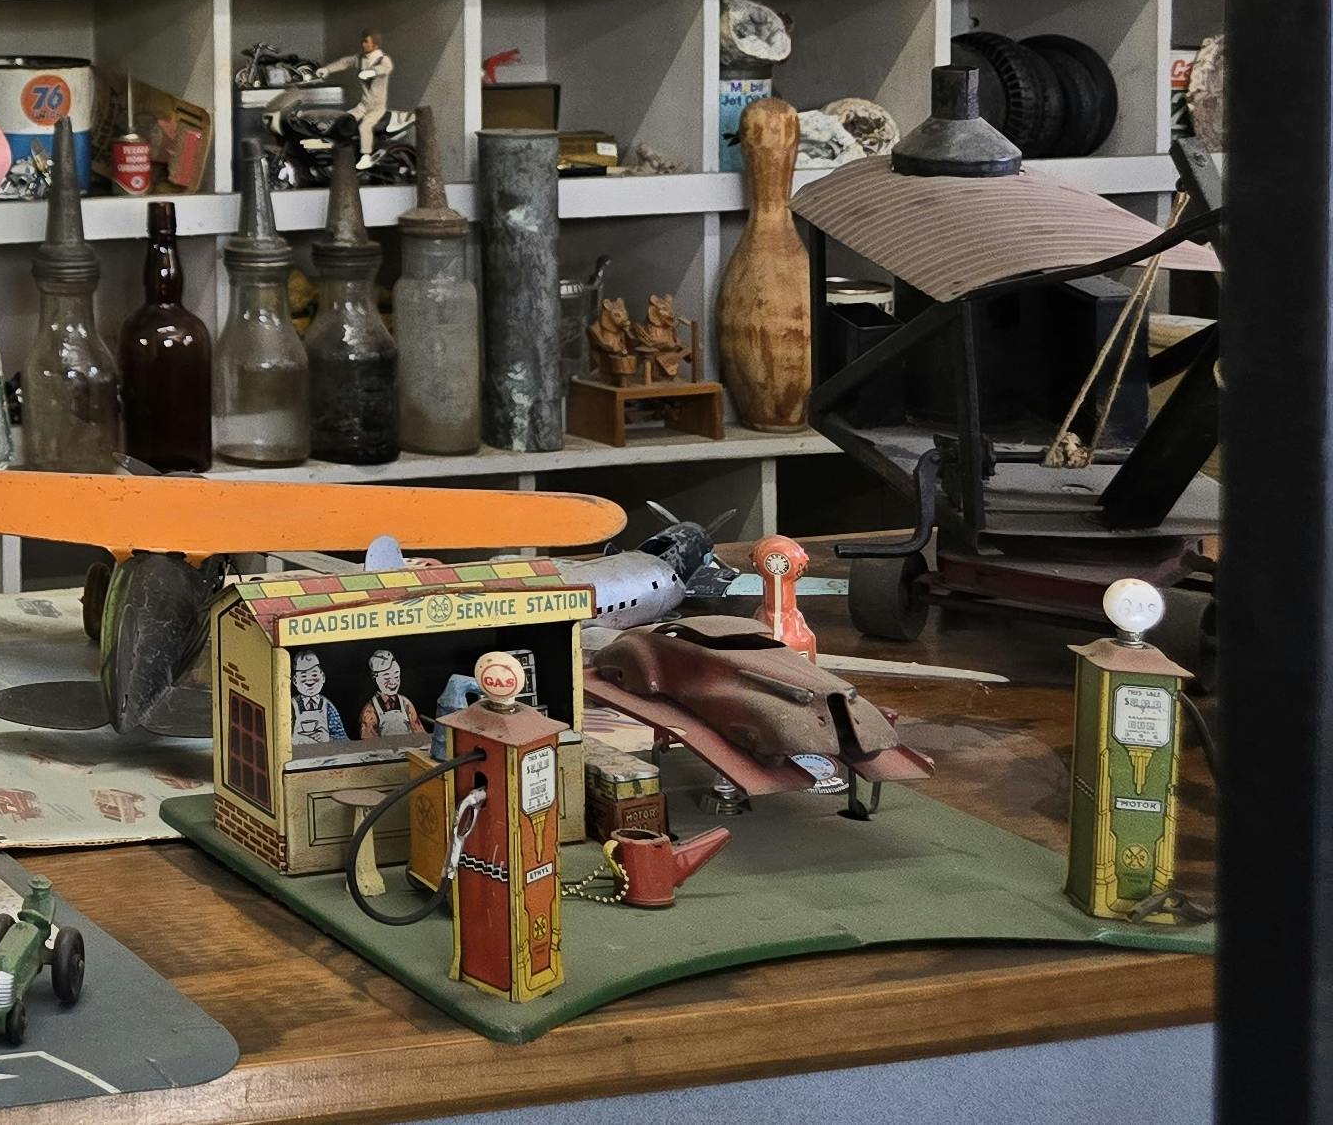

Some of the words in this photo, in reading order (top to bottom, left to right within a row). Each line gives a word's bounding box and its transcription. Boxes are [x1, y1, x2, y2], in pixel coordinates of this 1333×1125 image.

[32, 86, 64, 110] 76
[1119, 597, 1158, 616] GAS
[289, 612, 378, 636] ROADSIDE
[386, 607, 423, 627] REST
[457, 599, 517, 621] SERVICE
[527, 591, 588, 614] STATION
[483, 675, 516, 688] GAS
[1120, 801, 1157, 809] MOTOR
[626, 810, 656, 821] MOTOR
[530, 868, 549, 879] ETHYL
